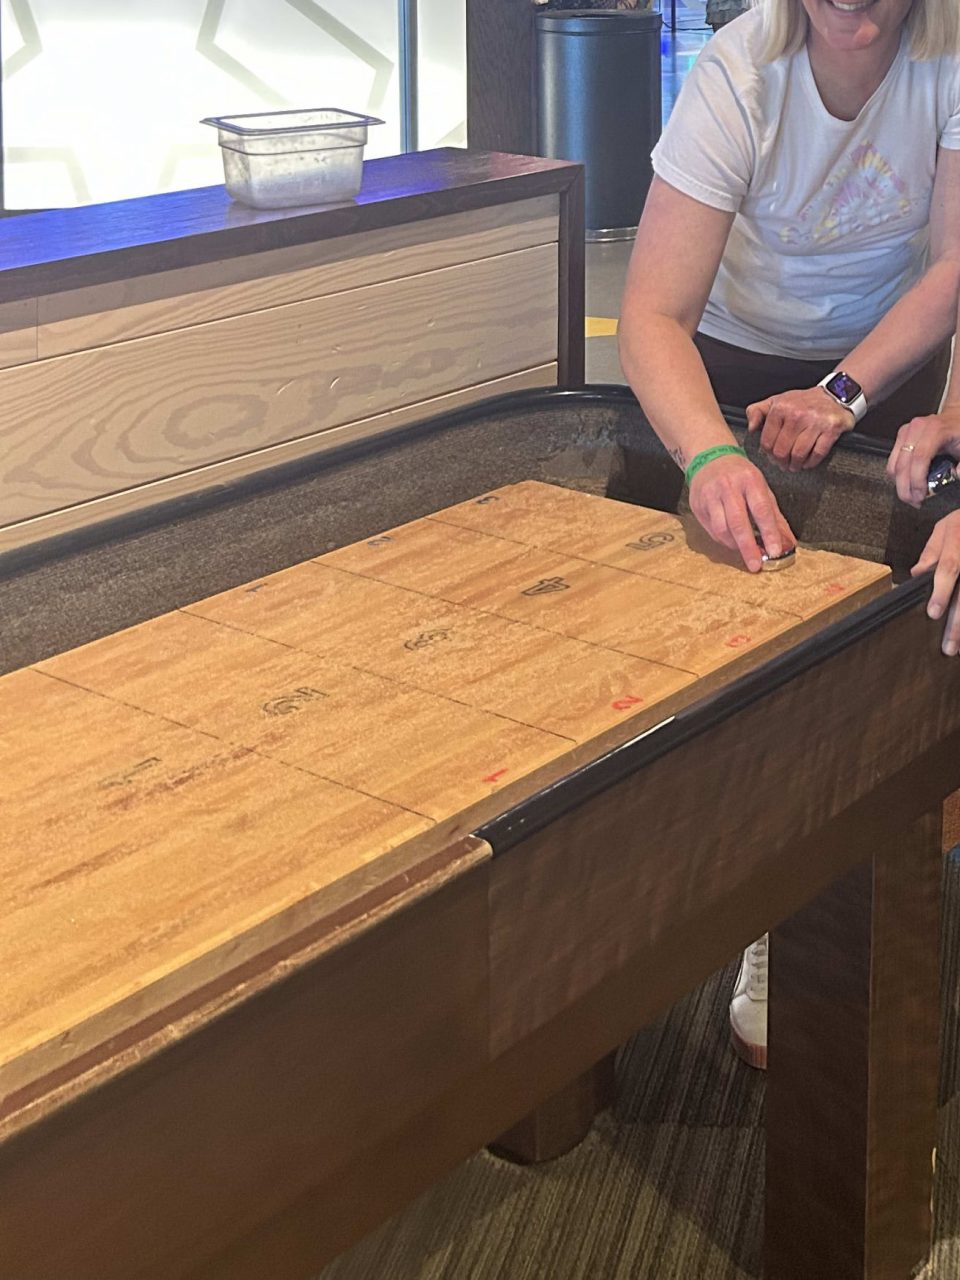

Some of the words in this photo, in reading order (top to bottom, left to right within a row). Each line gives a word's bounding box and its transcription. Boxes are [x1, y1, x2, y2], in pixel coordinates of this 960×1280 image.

[625, 531, 675, 551] 5
[521, 575, 571, 596] 4
[611, 694, 644, 710] 2
[482, 768, 509, 783] 1
